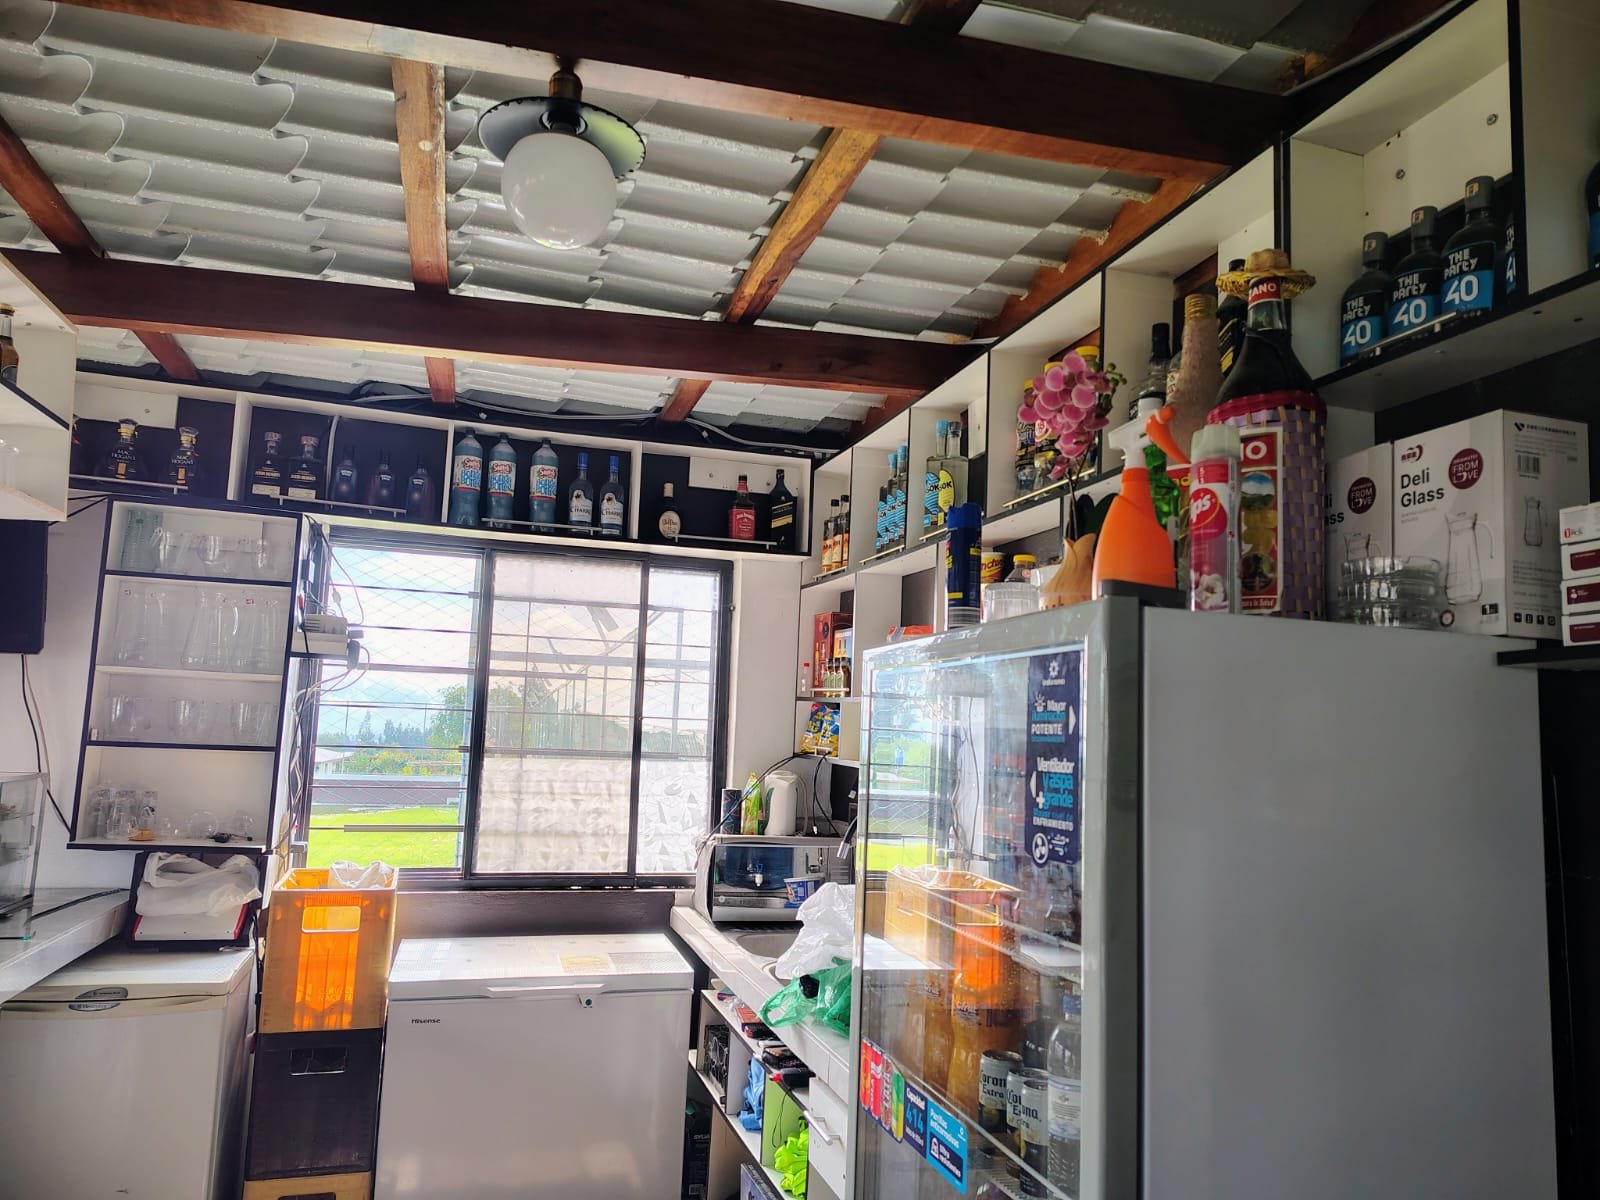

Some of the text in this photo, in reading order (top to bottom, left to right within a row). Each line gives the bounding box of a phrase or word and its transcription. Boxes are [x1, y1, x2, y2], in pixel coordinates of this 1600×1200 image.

[1448, 248, 1470, 265] THE
[1398, 273, 1420, 289] THE
[1444, 274, 1479, 305] 40
[1346, 296, 1364, 311] THE
[1393, 298, 1427, 327] 40
[1343, 320, 1372, 347] 40
[1453, 461, 1479, 474] FROM
[1401, 467, 1430, 489] Deli
[1401, 488, 1445, 508] Glass
[1037, 757, 1075, 774] Ventilador
[982, 1084, 1004, 1099] Extra
